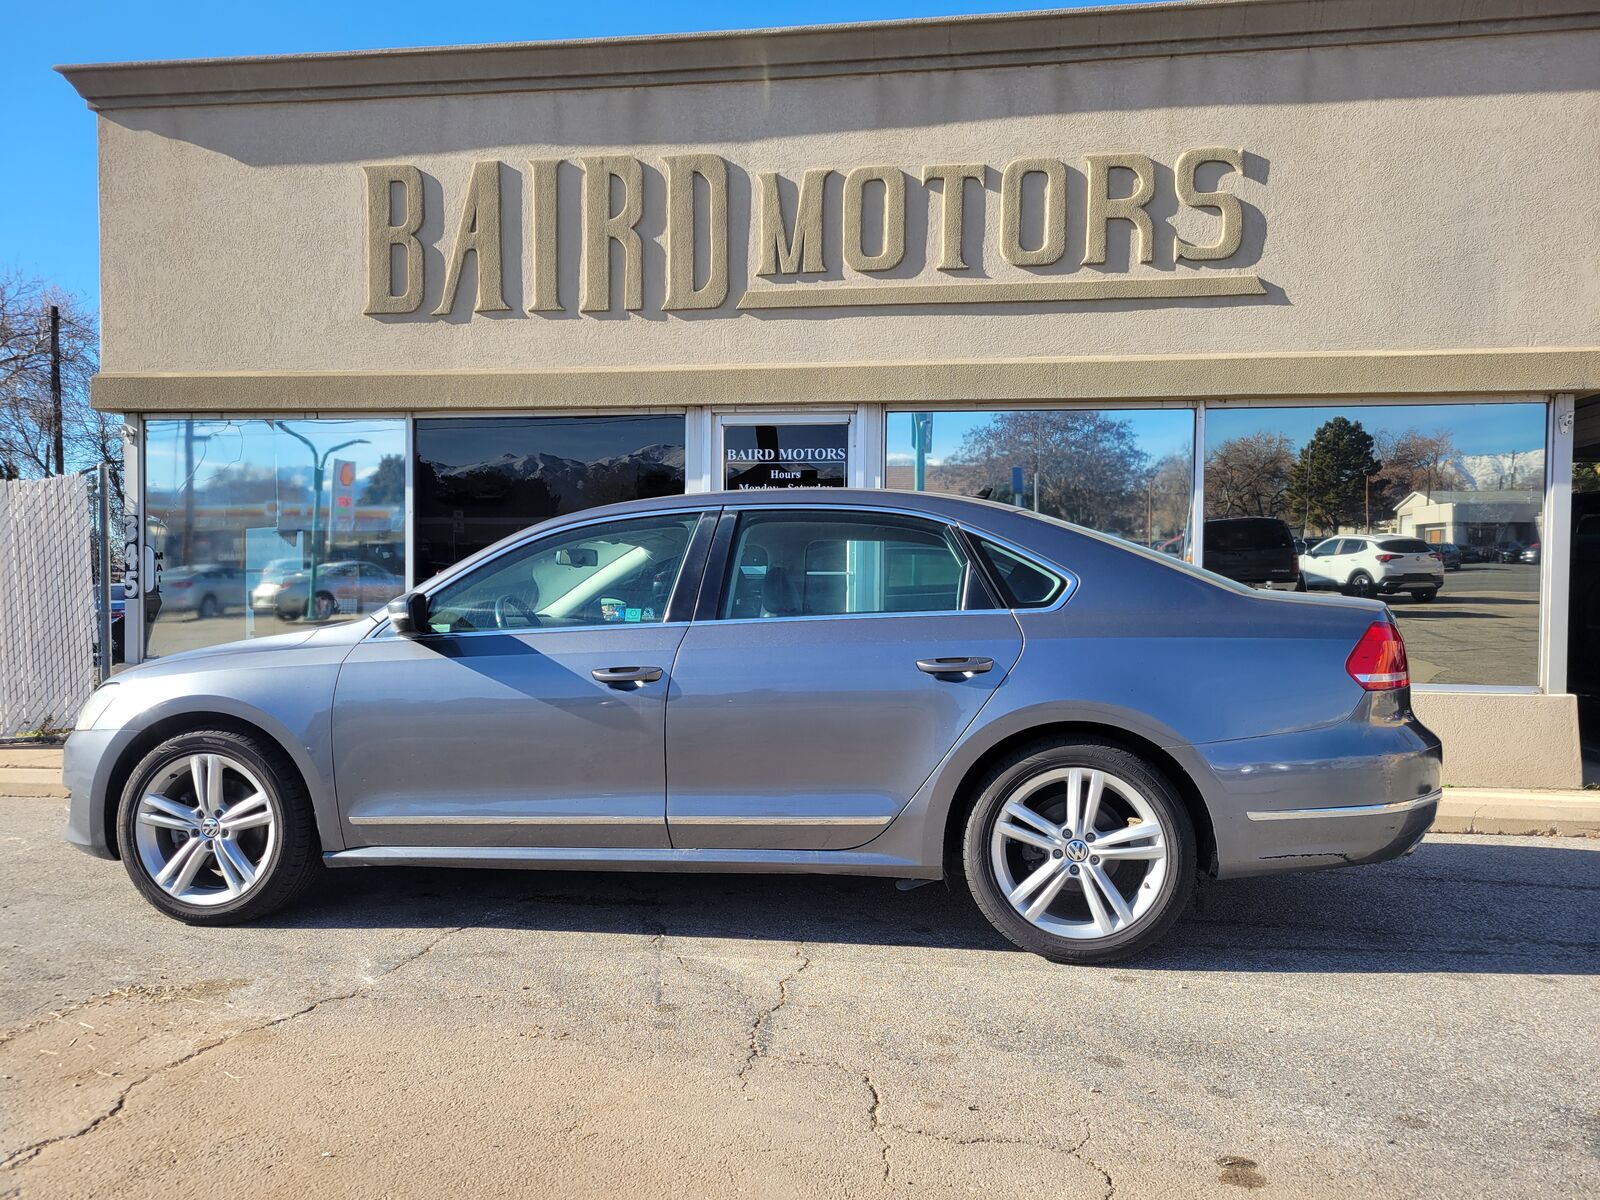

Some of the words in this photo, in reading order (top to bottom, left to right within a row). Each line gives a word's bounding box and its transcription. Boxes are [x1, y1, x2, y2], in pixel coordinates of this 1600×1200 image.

[362, 154, 730, 315] BAIRD
[756, 147, 1244, 276] MOTORS
[727, 449, 775, 461] BAIRD
[779, 448, 846, 460] MOTORS
[770, 470, 801, 479] Hours
[154, 552, 164, 593] MAIL
